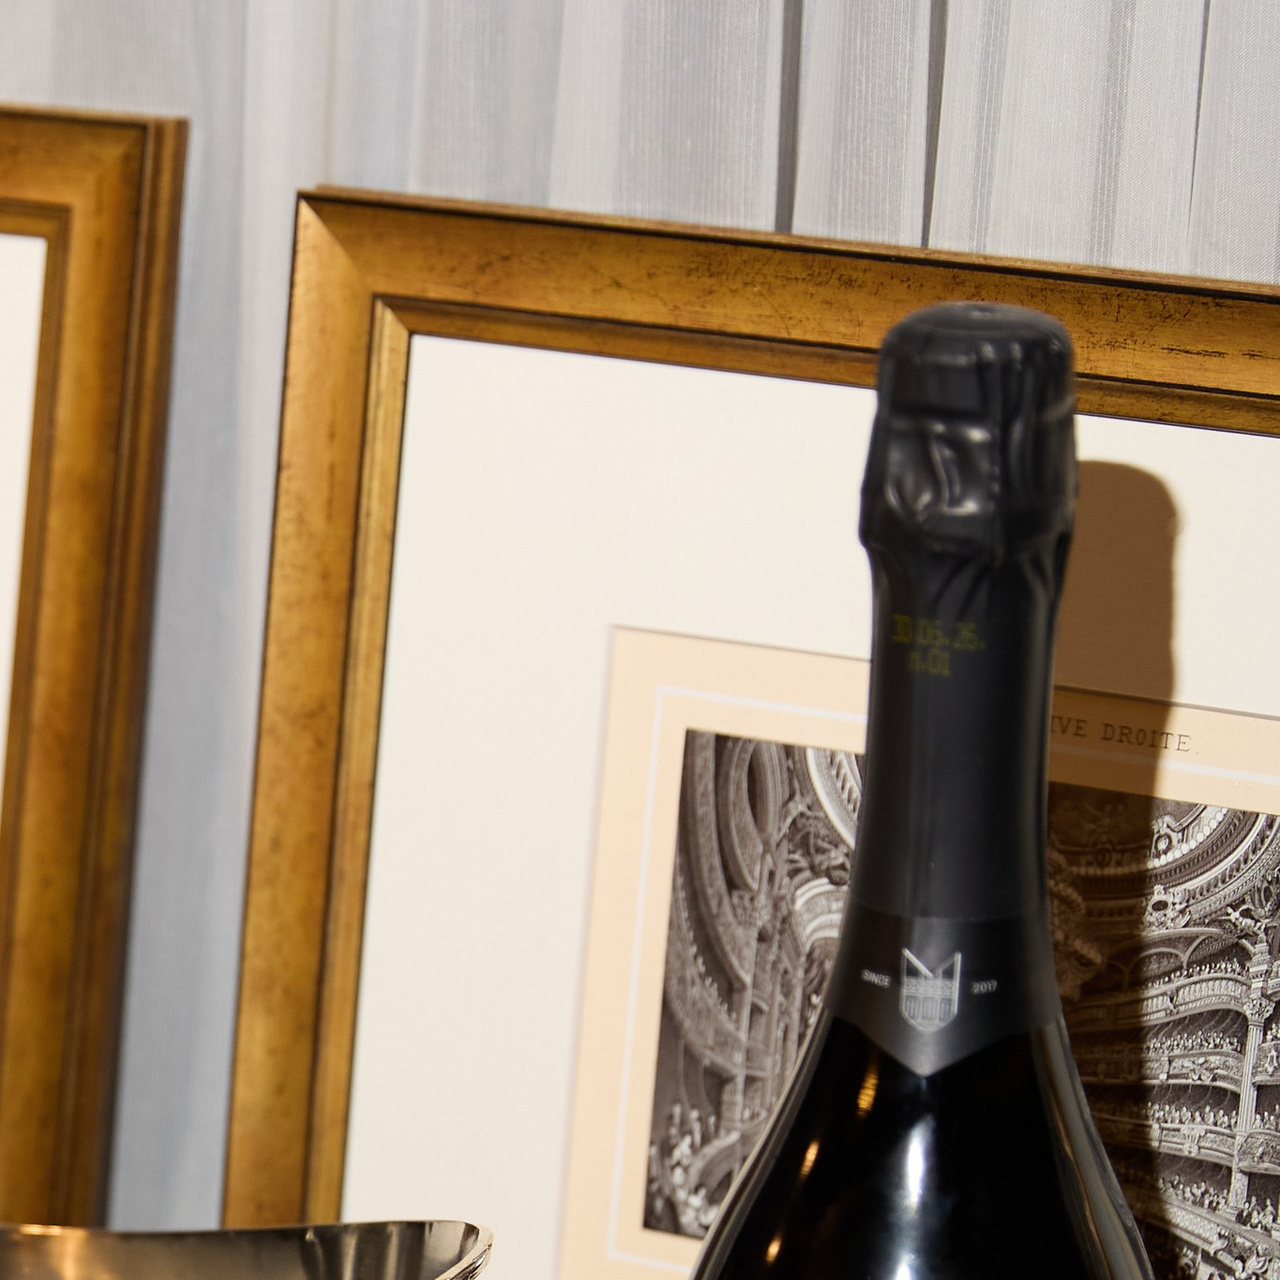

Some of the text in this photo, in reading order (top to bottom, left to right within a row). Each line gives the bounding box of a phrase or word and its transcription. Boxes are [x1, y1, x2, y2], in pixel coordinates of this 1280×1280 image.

[1050, 715, 1088, 738] IVE
[861, 969, 998, 995] SINCE 2017
